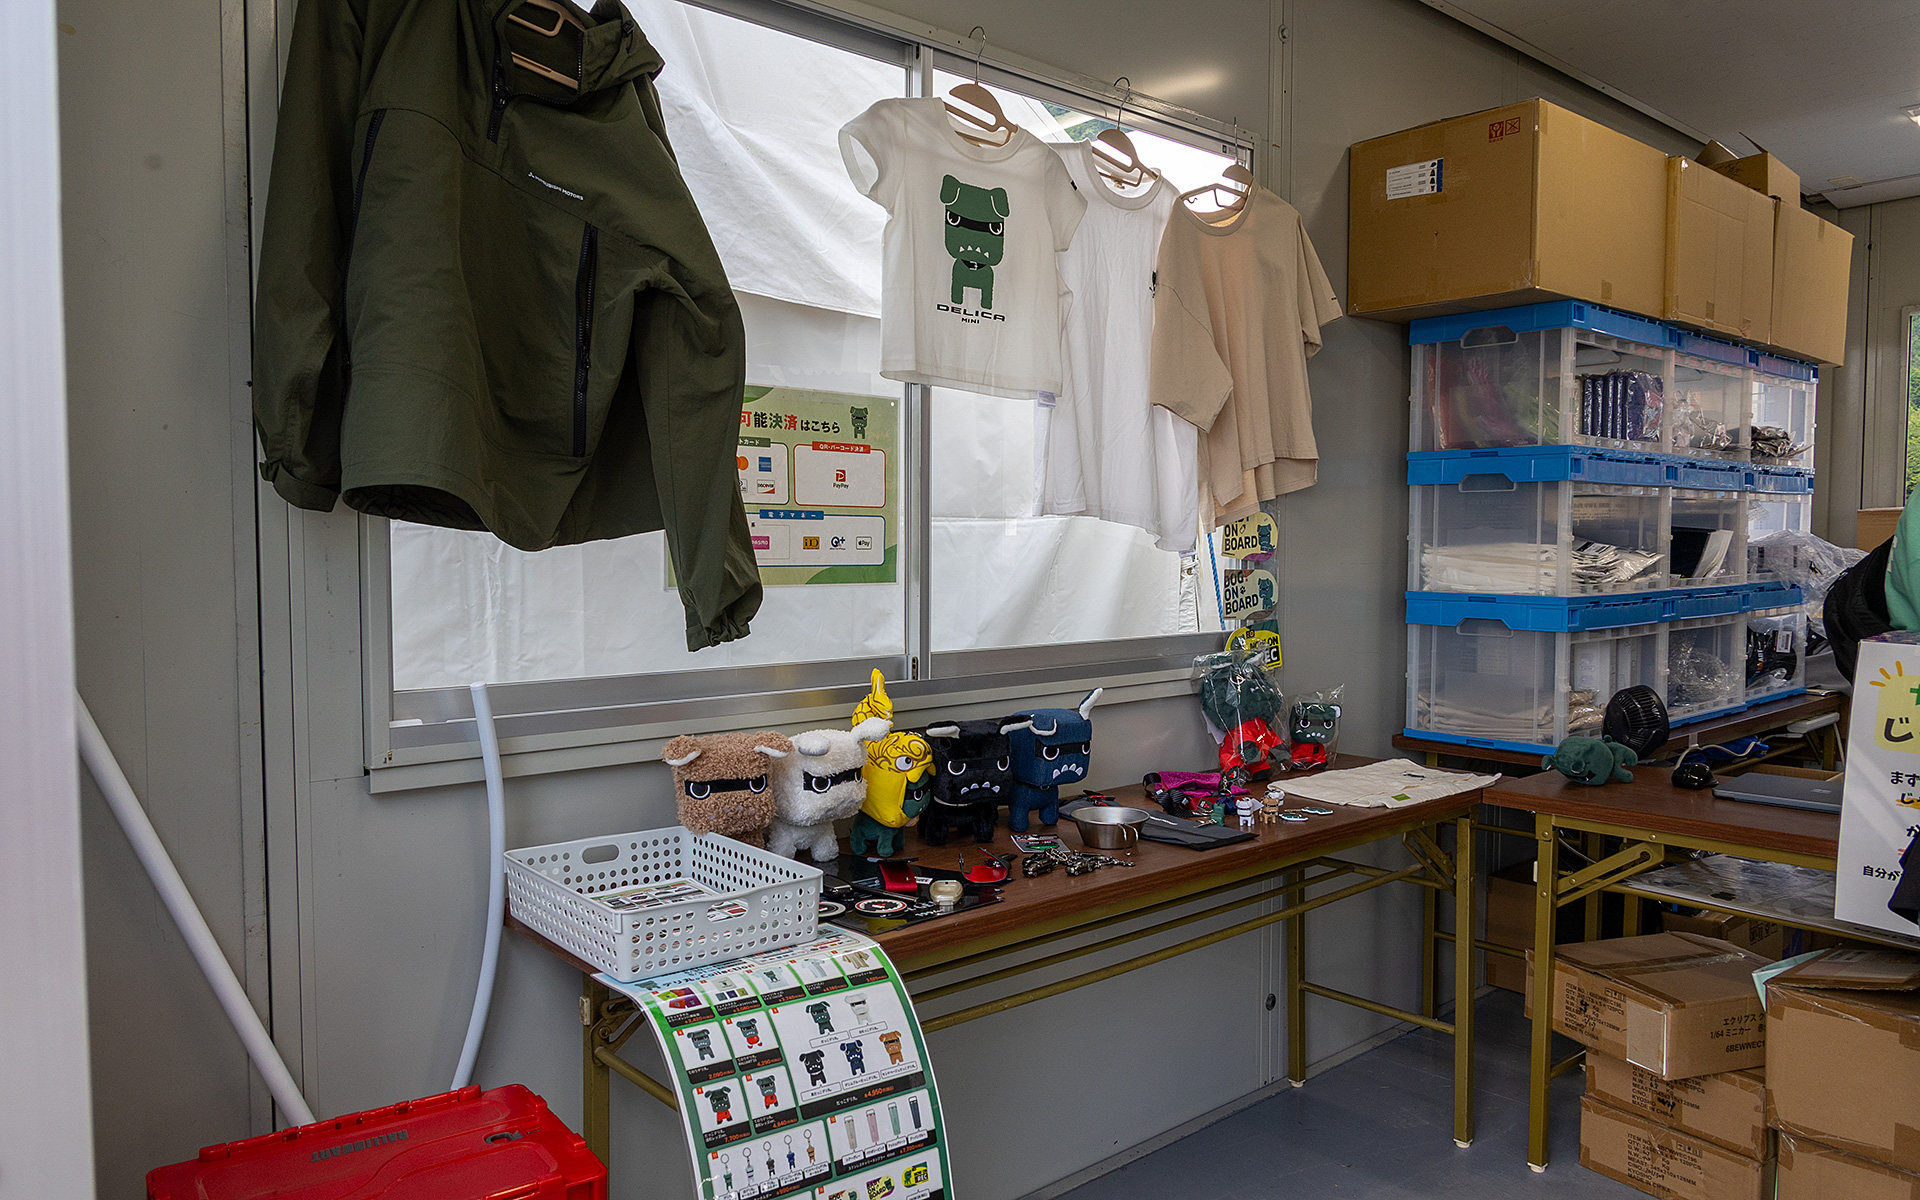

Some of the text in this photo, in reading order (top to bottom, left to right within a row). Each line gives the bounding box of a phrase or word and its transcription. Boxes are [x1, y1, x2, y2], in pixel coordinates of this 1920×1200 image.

[562, 189, 584, 200] MOTORS
[937, 304, 1005, 321] DELICA
[819, 444, 864, 452] QR・バーコード決済
[1224, 524, 1238, 537] ON
[805, 538, 819, 547] iD
[1225, 536, 1258, 551] BOARD
[1225, 586, 1238, 601] ON
[1226, 594, 1258, 615] BOARD
[1267, 636, 1278, 646] ON
[1890, 771, 1920, 787] まず
[1901, 793, 1920, 805] じ
[1723, 1014, 1757, 1026] エクリプス
[1584, 1030, 1599, 1041] CHINA
[1710, 1030, 1724, 1039] 1/64
[1726, 1027, 1751, 1037] ミニカー
[1632, 1094, 1656, 1106] KYOSHO
[1632, 1100, 1647, 1110] MADE
[1656, 1108, 1674, 1119] CHINA
[1627, 1132, 1641, 1142] ITEM
[1680, 1158, 1702, 1171] 120PCS
[1627, 1167, 1652, 1180] KYOSHO
[1627, 1173, 1645, 1184] MADE
[1652, 1183, 1671, 1193] CHINA
